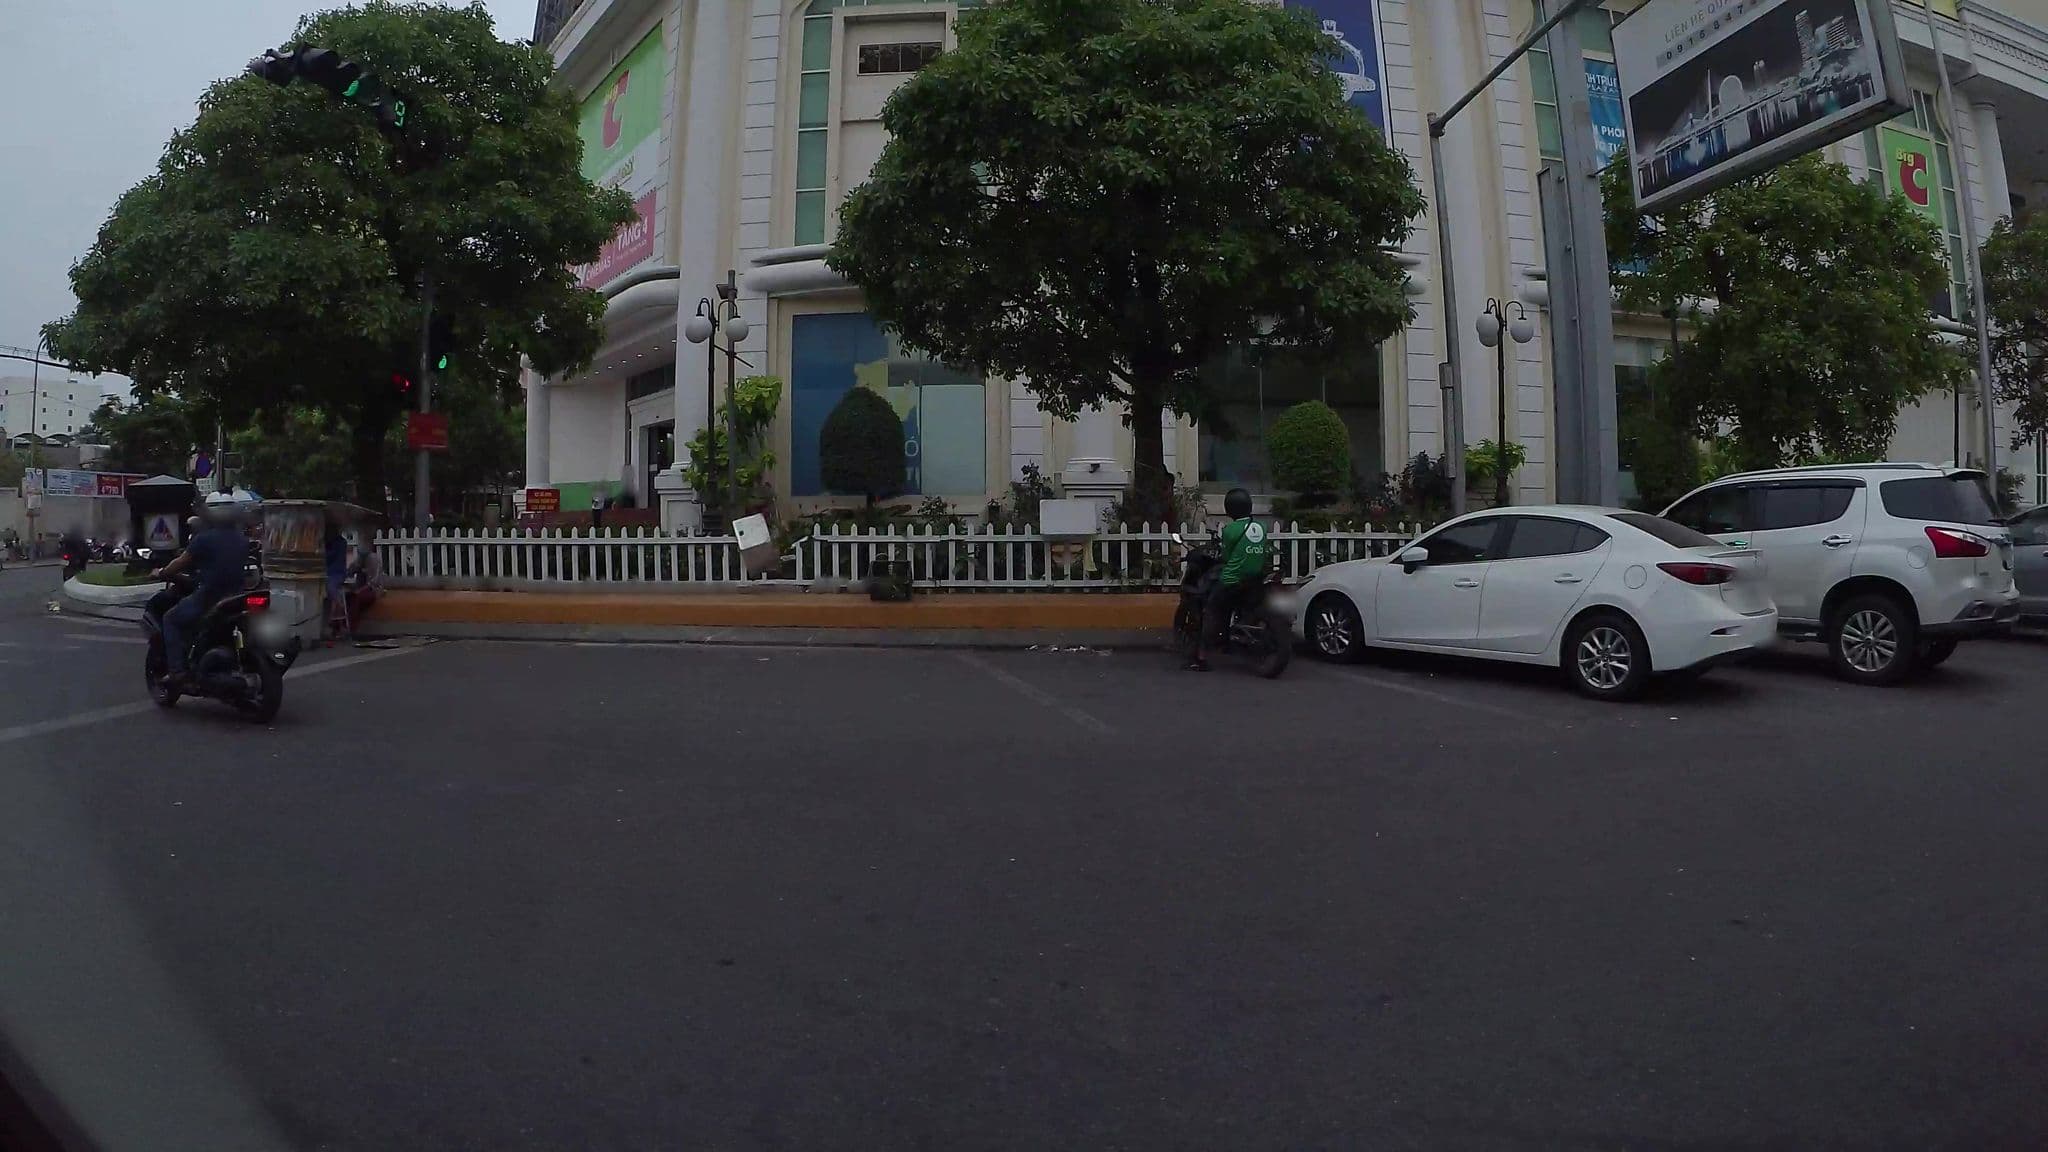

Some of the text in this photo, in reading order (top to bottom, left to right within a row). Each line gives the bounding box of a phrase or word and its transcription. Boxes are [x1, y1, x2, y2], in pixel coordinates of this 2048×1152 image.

[394, 100, 405, 127] 9
[1895, 147, 1914, 167] Big
[1245, 545, 1264, 554] Grab
